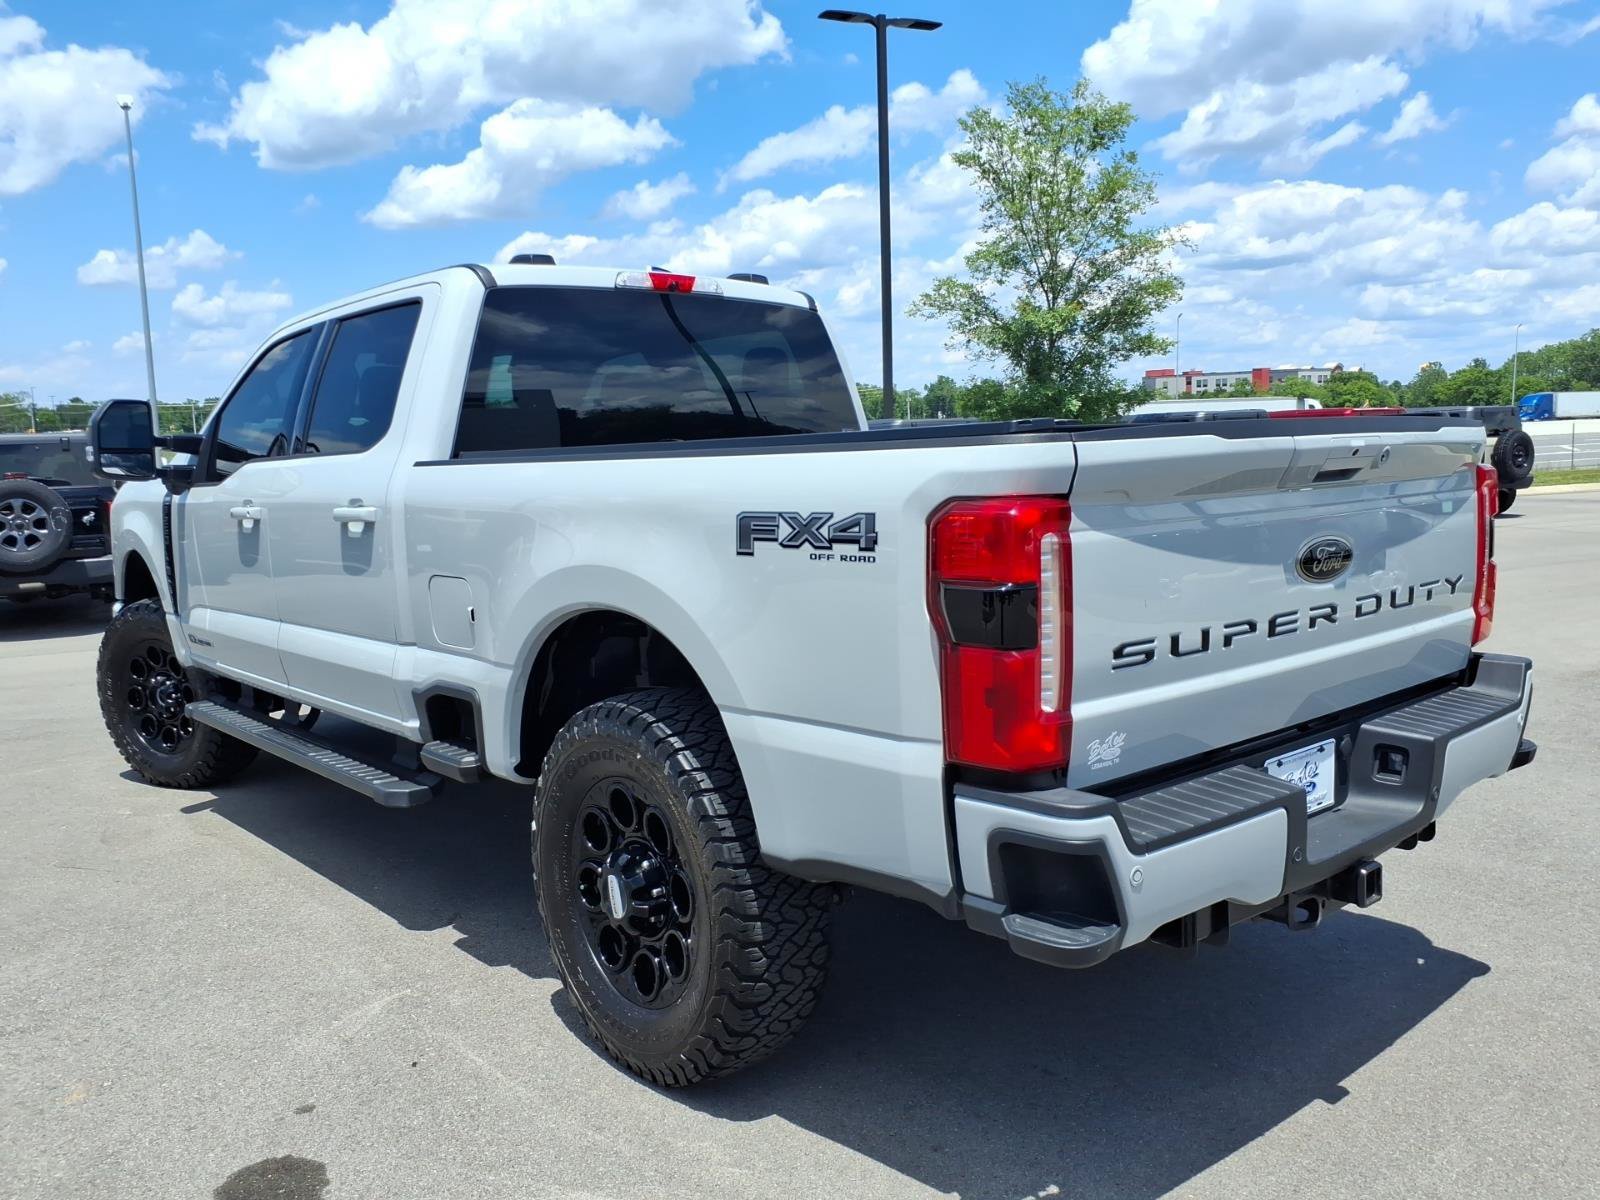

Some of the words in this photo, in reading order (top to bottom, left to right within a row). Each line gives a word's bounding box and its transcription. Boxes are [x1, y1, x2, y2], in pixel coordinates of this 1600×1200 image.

[736, 511, 878, 556] FX4
[809, 552, 835, 561] OFF
[840, 554, 876, 563] ROAD
[1312, 546, 1345, 573] Ford
[1111, 602, 1339, 672] SUPER
[1355, 574, 1464, 618] DUTY
